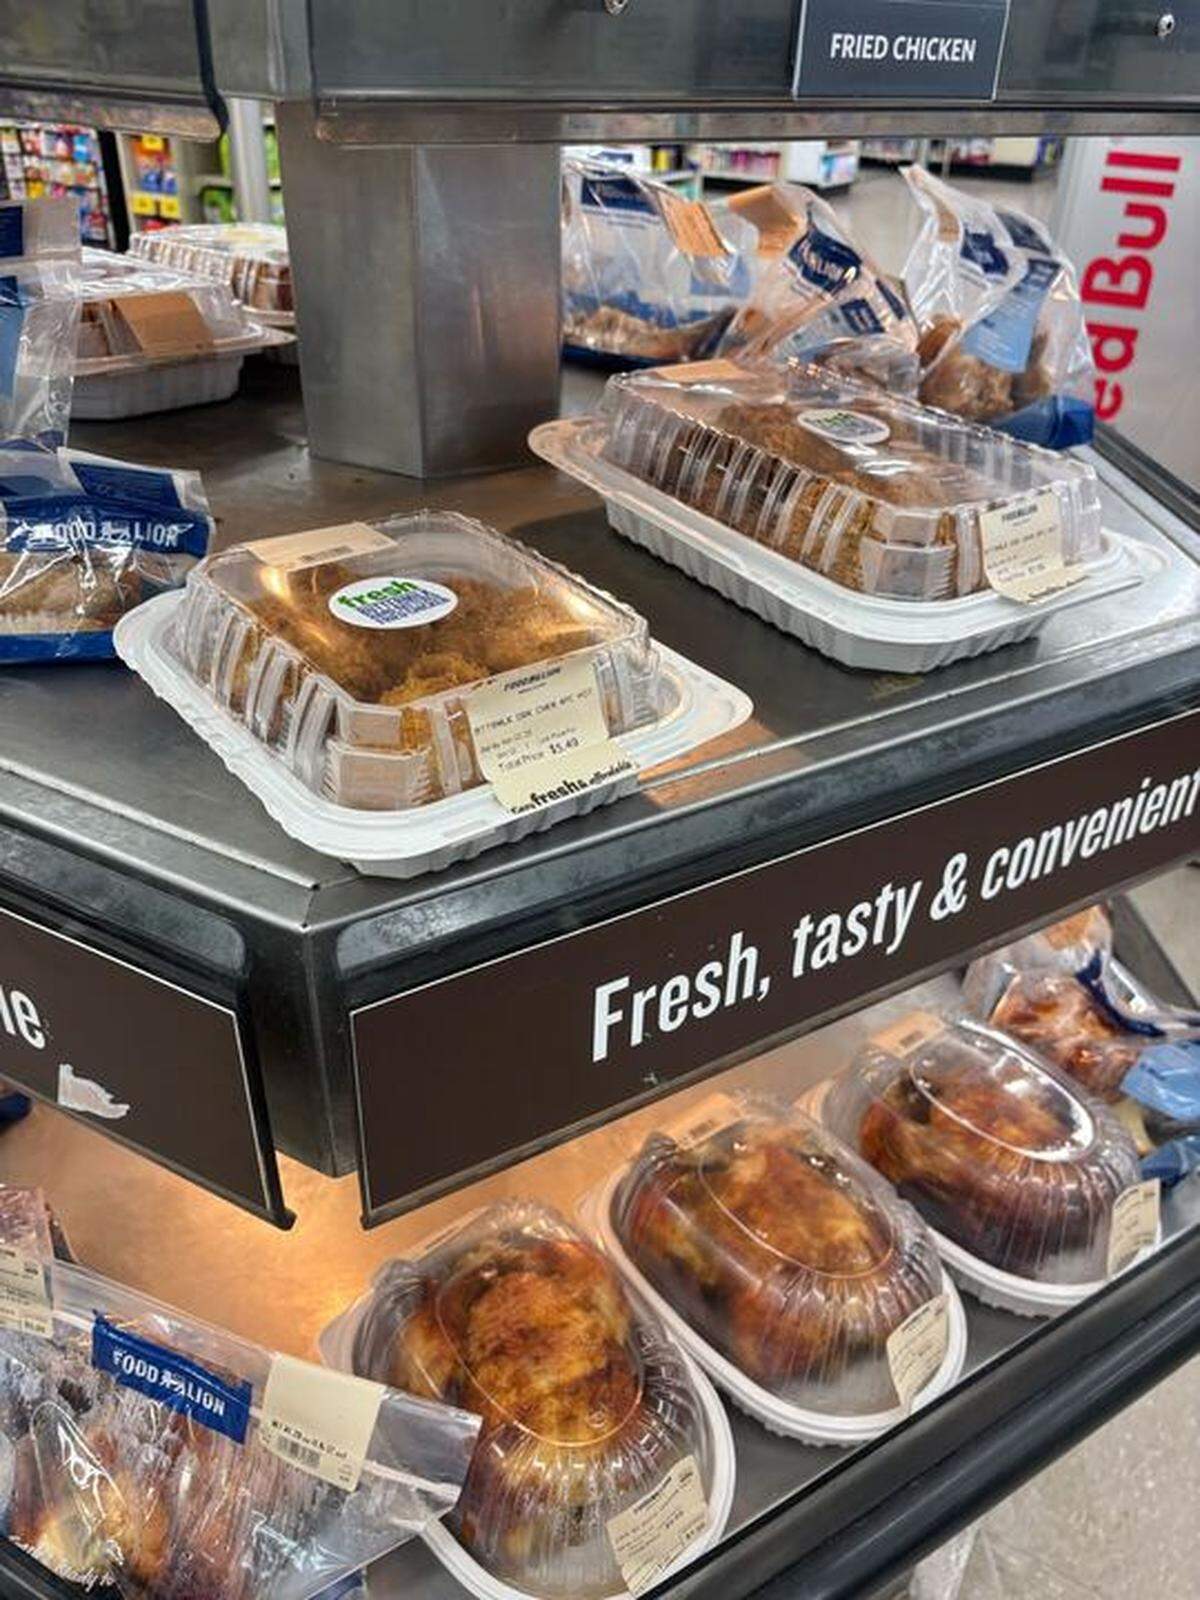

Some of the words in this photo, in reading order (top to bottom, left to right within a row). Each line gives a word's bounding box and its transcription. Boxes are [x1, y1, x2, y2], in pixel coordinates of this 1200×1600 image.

[830, 33, 889, 59] FRIED
[892, 35, 977, 62] CHICKEN
[1080, 152, 1181, 310] Bull
[1086, 323, 1138, 421] ed
[593, 931, 770, 1063] Fresh,
[792, 880, 923, 978] tasty
[930, 852, 968, 921] &
[187, 1382, 226, 1416] LION
